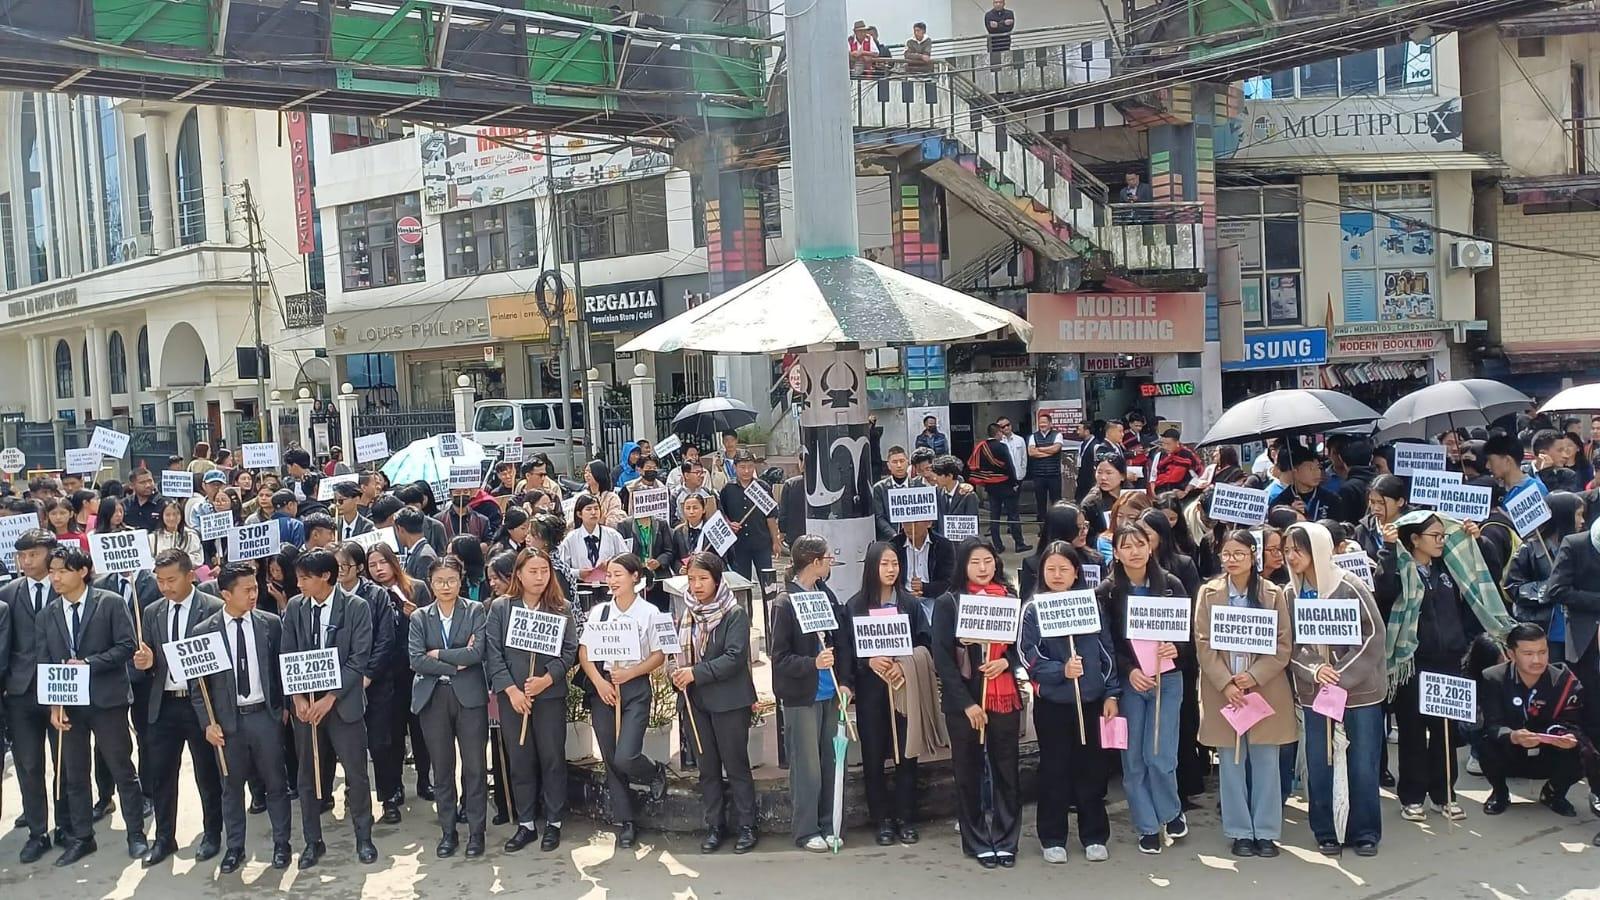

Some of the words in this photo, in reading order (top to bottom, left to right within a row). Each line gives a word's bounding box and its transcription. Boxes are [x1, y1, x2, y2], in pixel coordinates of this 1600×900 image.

[1283, 111, 1452, 138] MULTIPLEX
[585, 289, 657, 313] REGALIA
[1076, 296, 1157, 316] MOBILE
[592, 315, 619, 324] Provision
[619, 313, 635, 322] Store
[358, 326, 403, 342] LOUIS
[411, 318, 488, 337] PHILIPPE
[1059, 319, 1174, 340] REPAIRING
[1340, 341, 1378, 351] MODERN
[1383, 338, 1434, 350] BOOKLAND
[1141, 382, 1193, 397] EPAIRING
[441, 434, 456, 444] STOP
[1413, 452, 1433, 460] RIGHTS
[1434, 453, 1444, 461] ARE
[635, 496, 643, 505] NO
[645, 491, 667, 502] FORCED
[1216, 489, 1226, 497] NO
[1413, 488, 1426, 497] FOR
[1440, 490, 1489, 504] NAGALAND
[890, 493, 934, 506] NAGALAND
[1214, 497, 1248, 510] RESPECT
[1248, 503, 1264, 513] OUR
[1510, 491, 1542, 520] NAGALAND
[635, 502, 667, 514] SECULARISM
[892, 507, 905, 517] FOR
[905, 505, 931, 516] CHRIST
[1213, 507, 1262, 520] CULTURE/CHOICE
[1440, 502, 1454, 512] FOR
[1455, 504, 1484, 515] CHRIST
[1524, 505, 1544, 524] CHRIST
[239, 524, 269, 540] STOP
[715, 518, 732, 538] STOP
[710, 525, 726, 545] FORCED
[100, 534, 135, 550] STOP
[239, 538, 270, 550] FORCED
[103, 548, 139, 561] FORCED
[240, 547, 270, 559] POLICIES
[105, 559, 141, 571] POLICIES
[1087, 580, 1098, 588] UR
[810, 600, 830, 612] 2026
[961, 604, 988, 616] PEOPLE'S
[1037, 601, 1048, 609] NO
[1040, 608, 1076, 621] RESPECT
[1077, 606, 1096, 616] OUR
[1130, 606, 1148, 617] NAGA
[1149, 607, 1174, 618] RIGHTS
[1175, 608, 1188, 618] ARE
[1214, 612, 1225, 621] NO
[1297, 608, 1357, 622] NAGALAND
[534, 613, 561, 625] JANUARY
[960, 618, 985, 630] PEOPLE
[986, 619, 1011, 631] RIGHTS
[1042, 618, 1097, 630] CULTURE/CHOICE
[1129, 619, 1187, 631] NON-NEGOTIABLE
[531, 621, 560, 637] 2026
[588, 623, 632, 632] NAGALIM
[856, 622, 908, 637] NAGALAND
[1214, 623, 1253, 635] RESPECT
[1255, 626, 1274, 637] OUR
[1298, 623, 1316, 635] FOR
[1318, 624, 1353, 636] CHRIST
[510, 637, 556, 653] SECULARISM
[602, 635, 620, 644] FOR
[858, 639, 874, 650] FOR
[874, 637, 904, 649] CHRIST
[1214, 635, 1273, 648] CULTURE/CHOICE
[176, 637, 211, 656] STOP
[593, 647, 631, 656] CHRIST!
[180, 651, 216, 668] FORCED
[305, 650, 334, 661] JANUARY
[184, 661, 220, 677] POLICIES
[304, 658, 335, 674] 2026
[48, 667, 78, 681] STOP
[48, 682, 78, 692] FORCED
[287, 678, 337, 693] SECULARISM
[1446, 678, 1472, 689] JANUARY
[48, 694, 79, 703] POLICIES
[1445, 686, 1472, 702] 2026
[1425, 703, 1472, 720] SECULARISM
